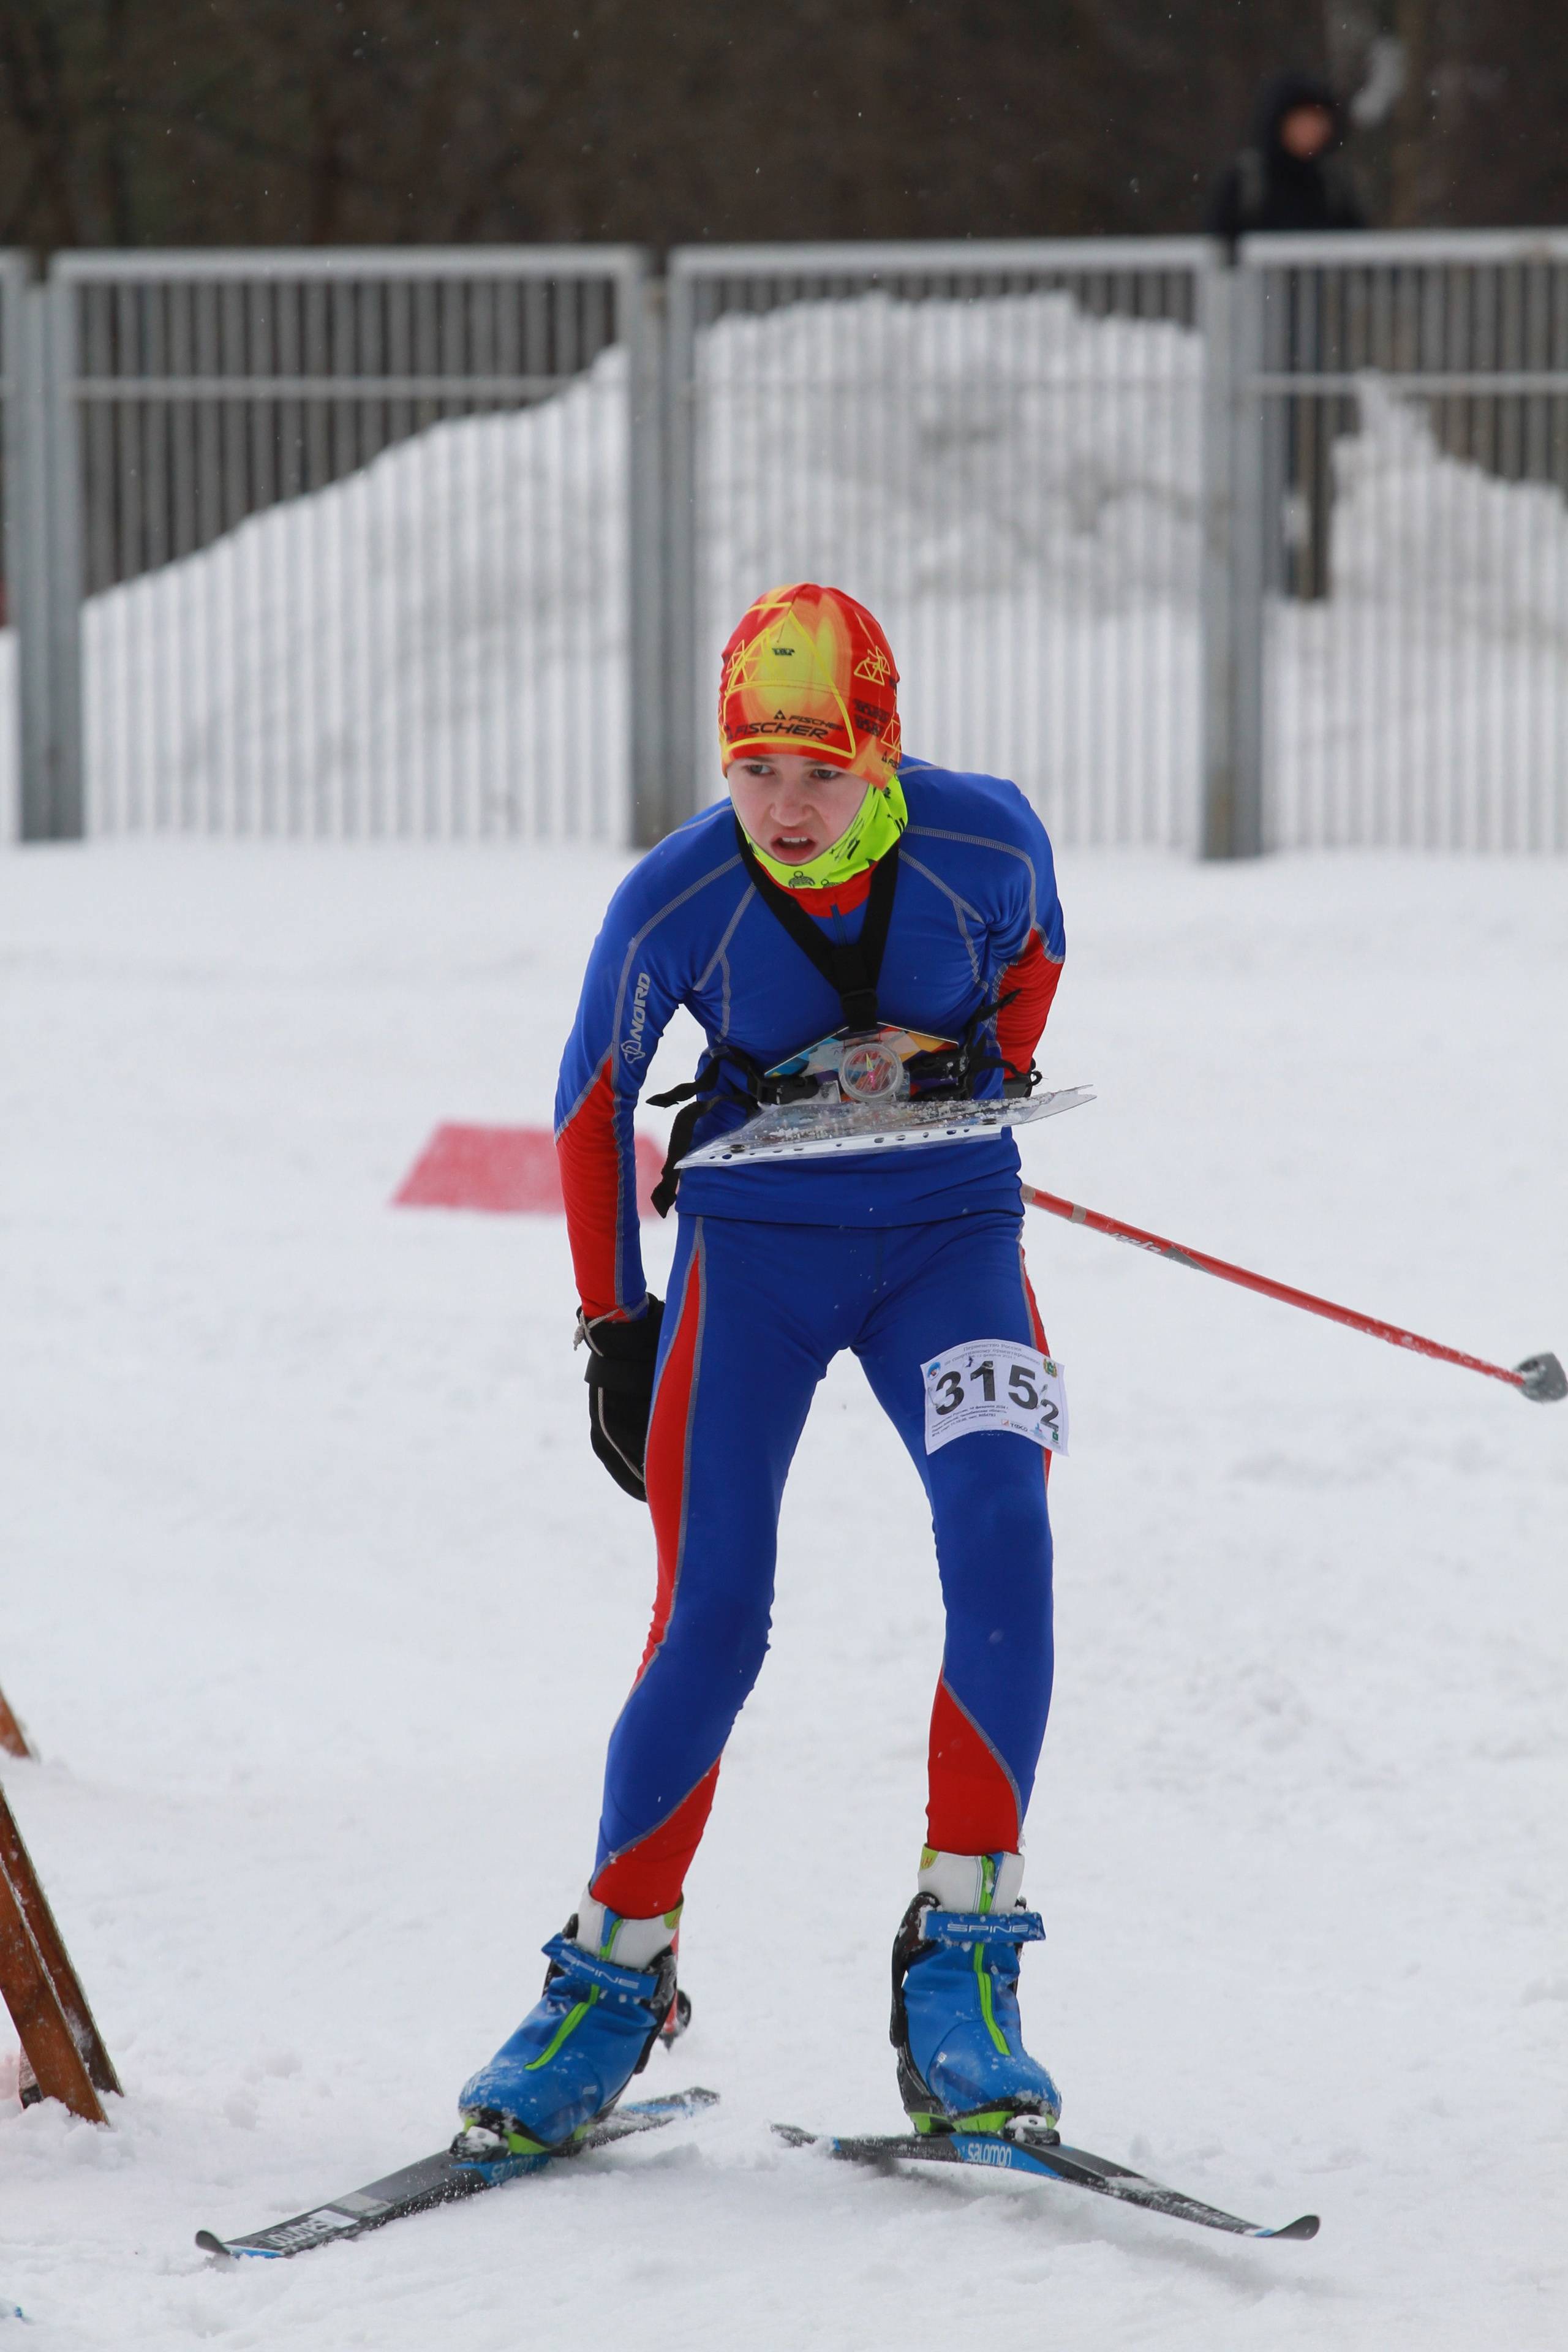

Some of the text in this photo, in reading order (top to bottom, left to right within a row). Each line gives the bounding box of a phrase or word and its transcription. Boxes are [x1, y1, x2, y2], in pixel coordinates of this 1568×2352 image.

[735, 722, 829, 740] FISCHER
[788, 715, 845, 731] FISCHER
[630, 972, 650, 1041] NORD
[947, 1923, 1028, 1934] SPINE
[968, 2143, 1011, 2167] salomon
